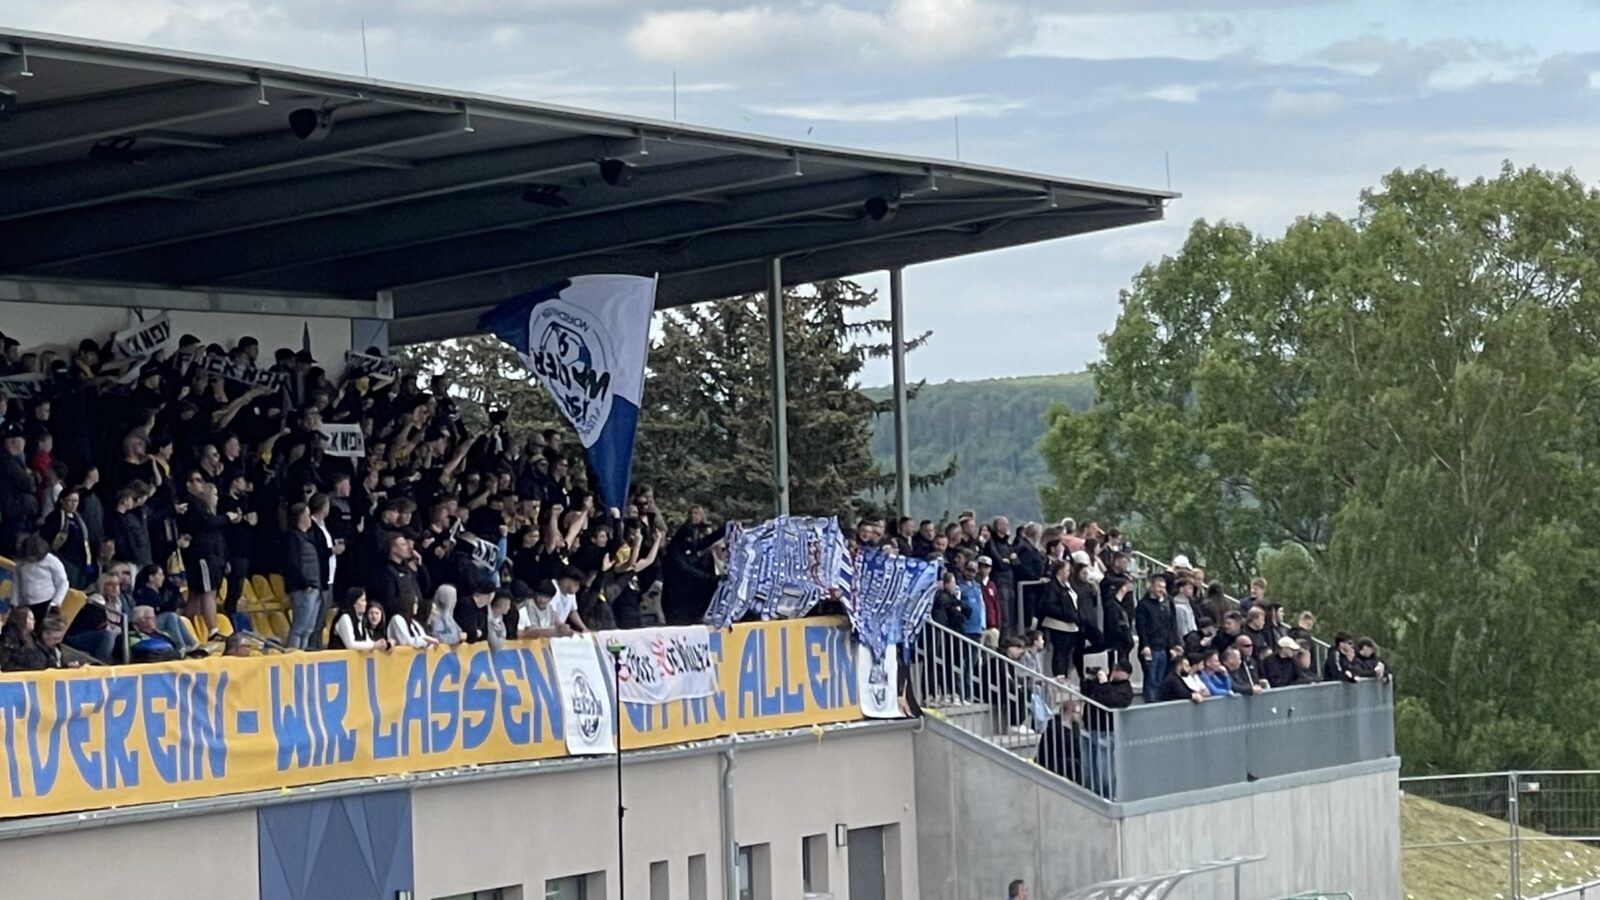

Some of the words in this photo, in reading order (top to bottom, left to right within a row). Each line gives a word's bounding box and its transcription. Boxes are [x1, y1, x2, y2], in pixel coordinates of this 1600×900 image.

[0, 671, 228, 798] TVEREIN
[271, 660, 356, 772] WIR
[366, 646, 563, 760] LASSEN
[738, 625, 858, 720] ALLEIN
